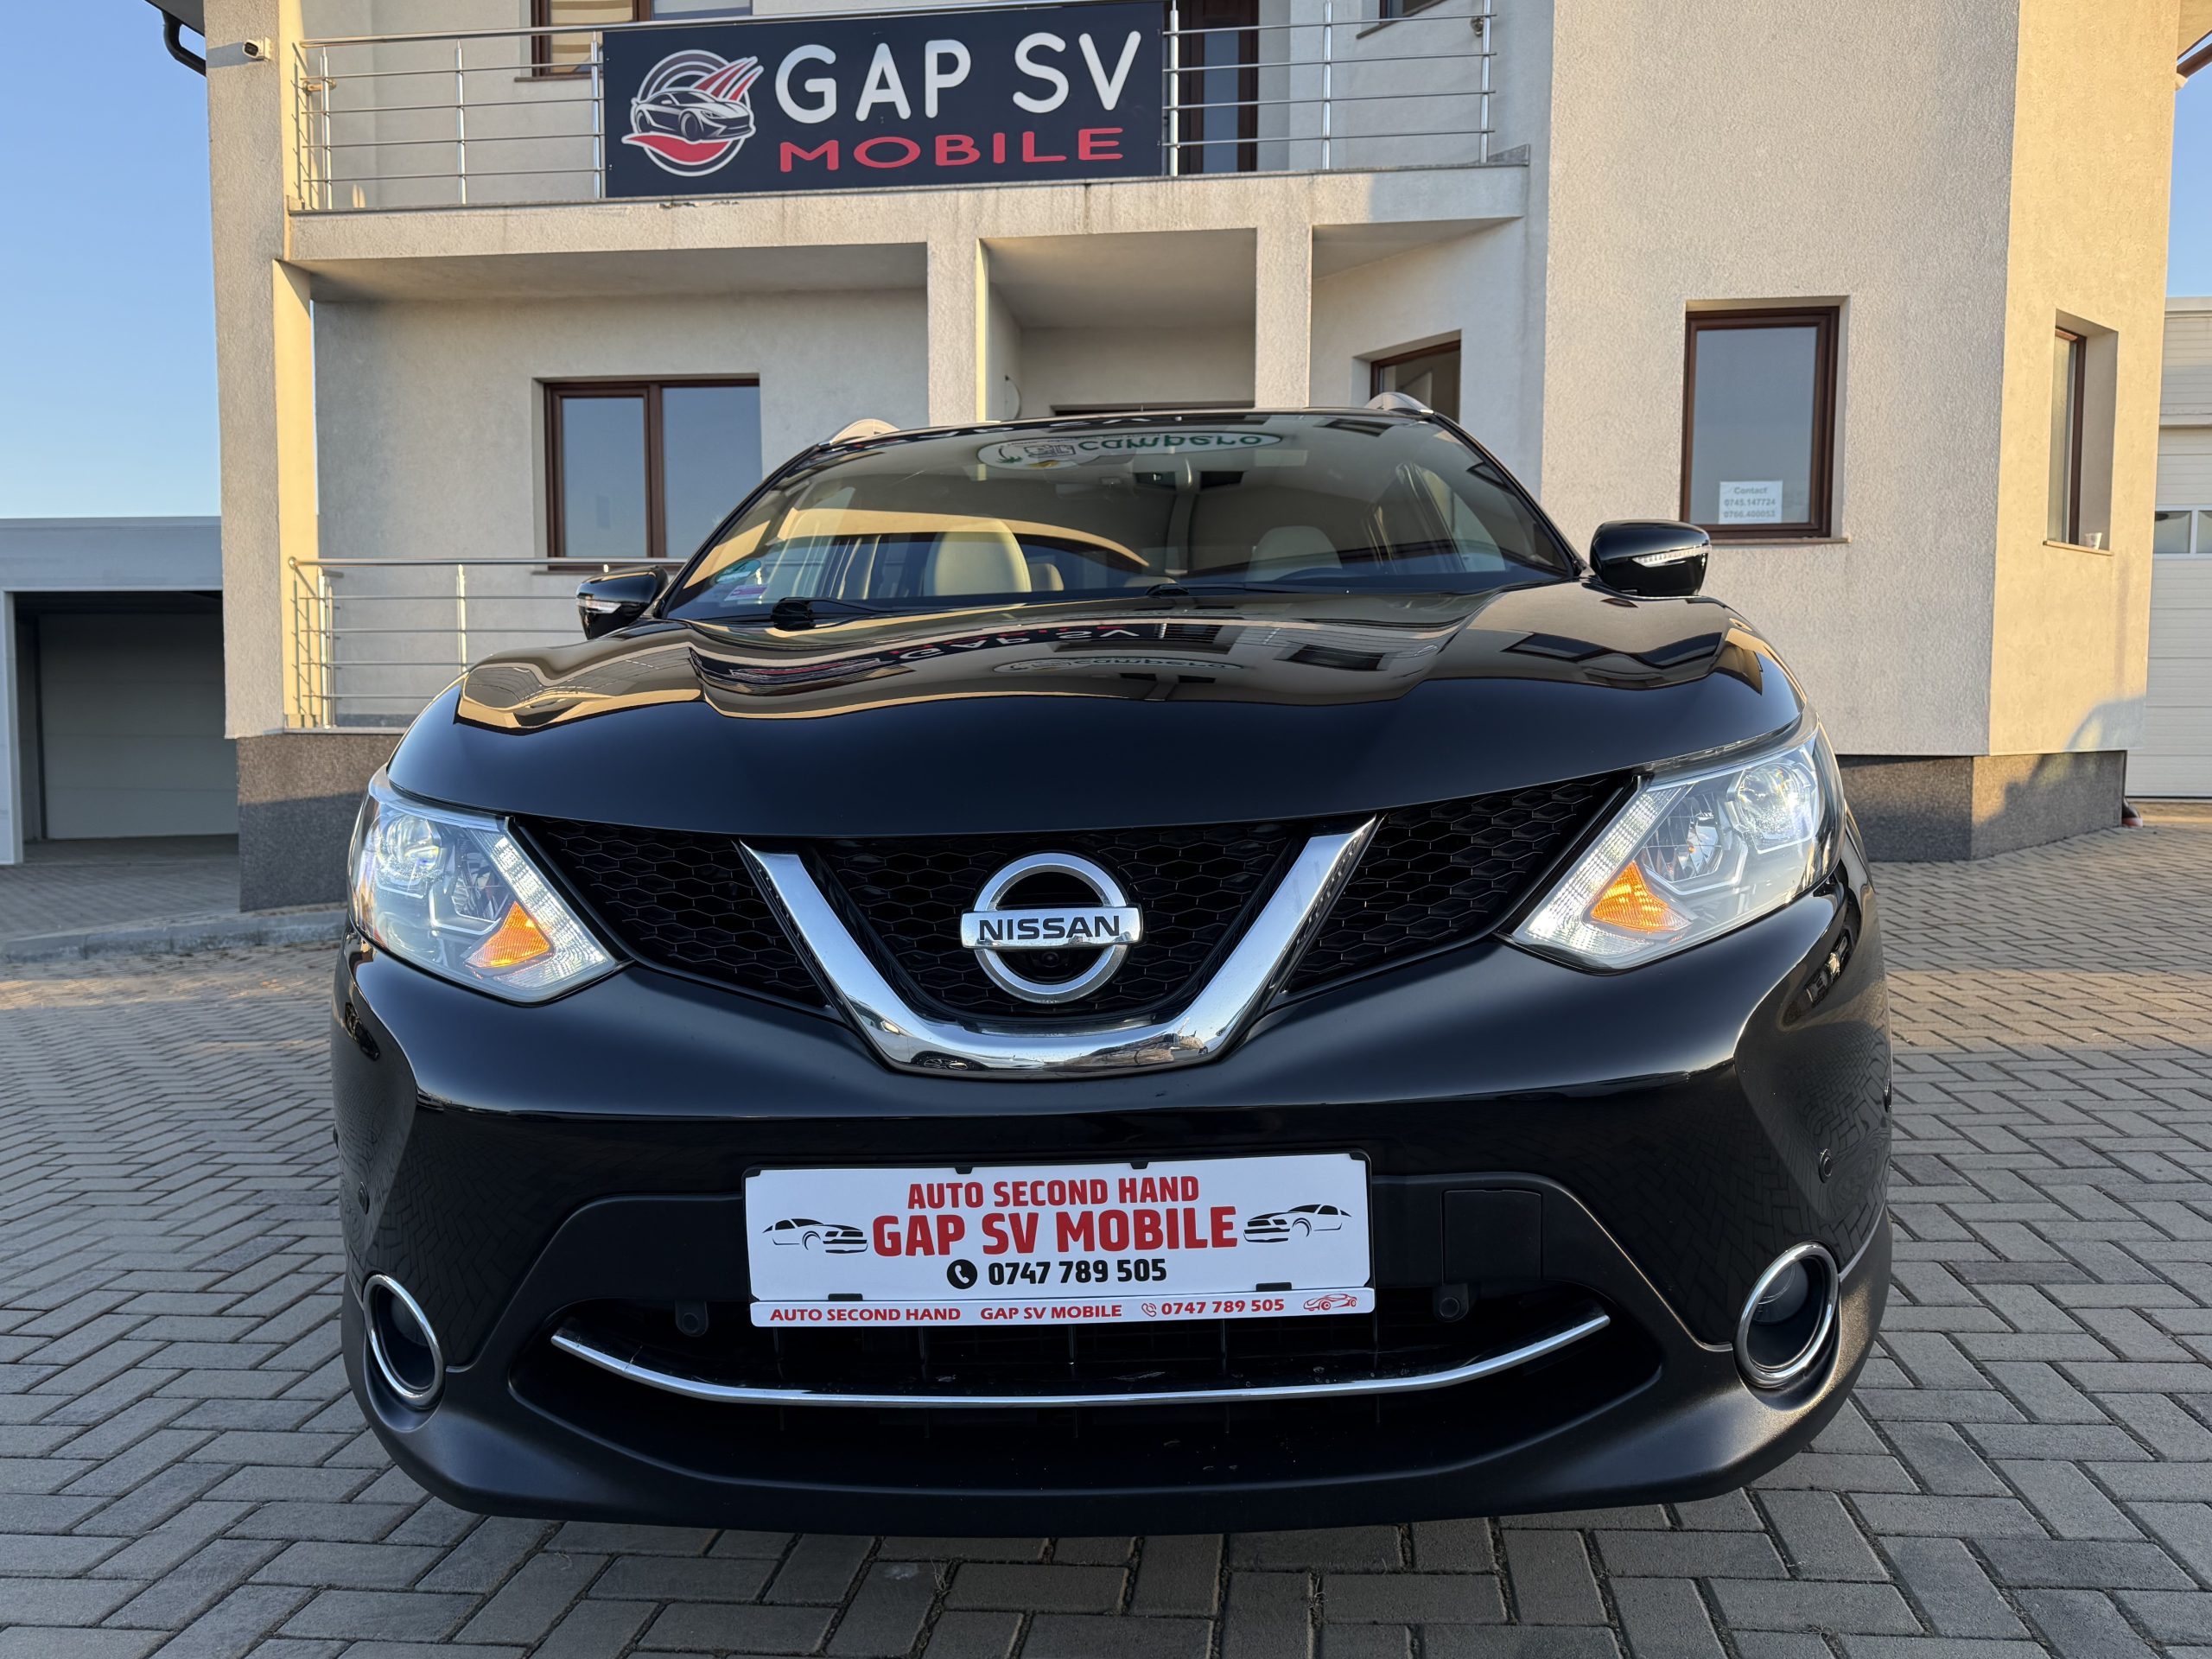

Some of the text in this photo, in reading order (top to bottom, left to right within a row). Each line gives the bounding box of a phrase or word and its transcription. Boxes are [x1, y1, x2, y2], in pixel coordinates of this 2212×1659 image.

[776, 31, 1141, 124] GAP SV
[779, 128, 1123, 172] MOBILE
[979, 916, 1120, 941] NISSAN
[908, 1176, 1199, 1210] AUTO SECOND HAND
[873, 1206, 1237, 1257] GAP SV MOBILE
[988, 1258, 1167, 1286] 0747 789 505
[769, 1307, 962, 1321] AUTO SECOND HAND
[981, 1305, 1122, 1320] GAP SV MOBILE
[1161, 1299, 1285, 1315] 0747 789 505
